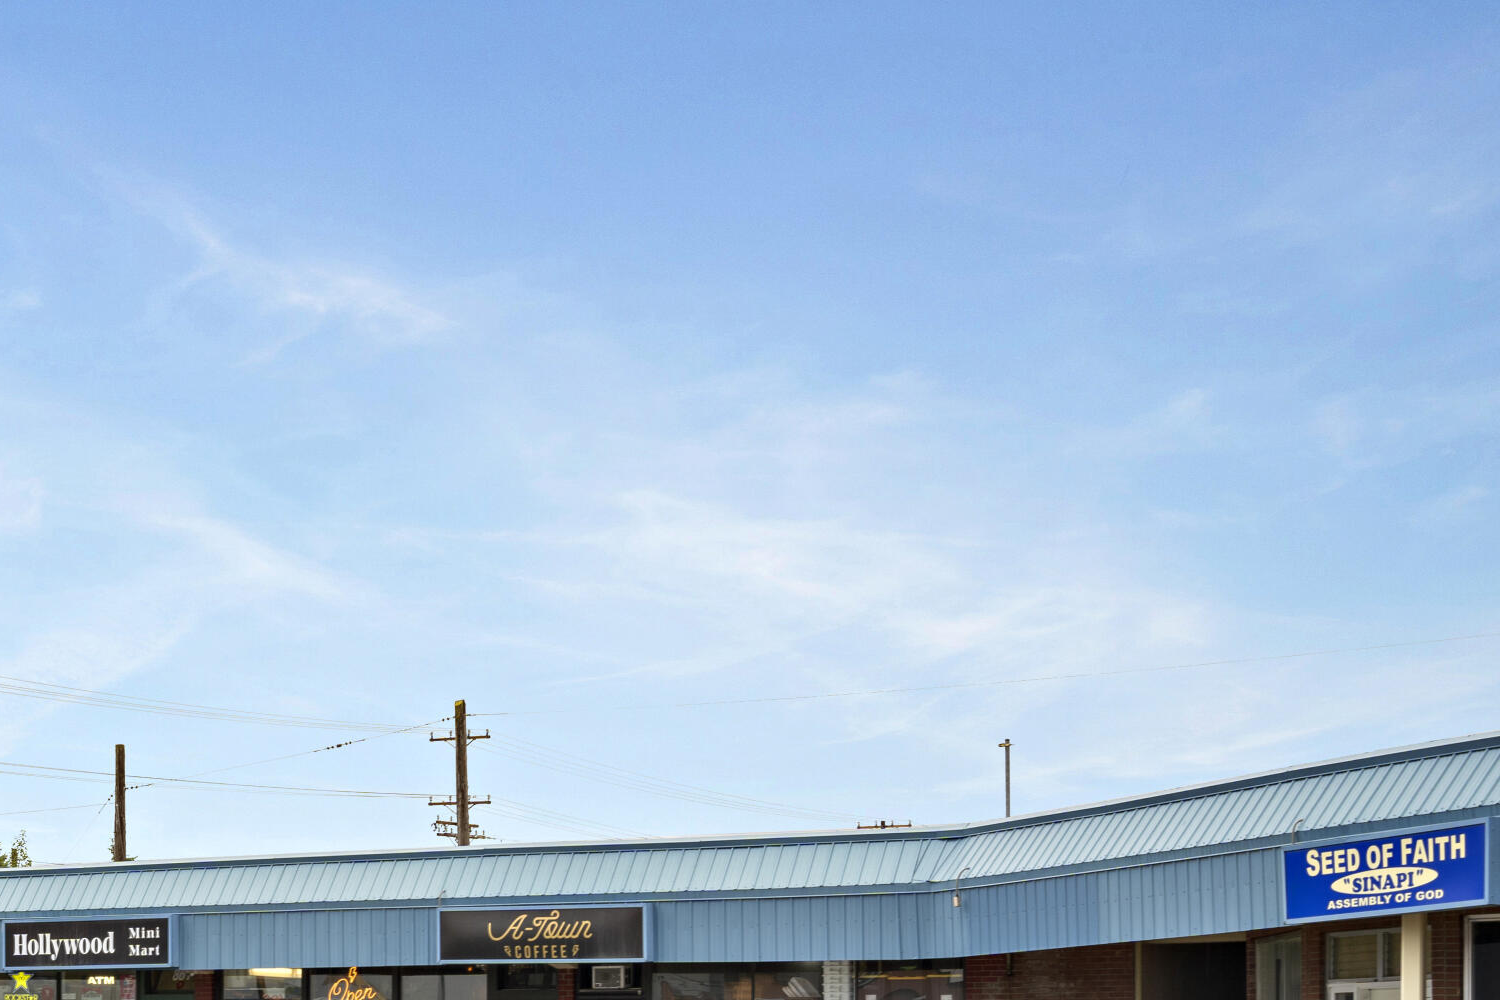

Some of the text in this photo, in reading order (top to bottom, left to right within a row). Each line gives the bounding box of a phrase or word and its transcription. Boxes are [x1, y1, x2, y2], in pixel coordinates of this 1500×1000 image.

[1306, 833, 1466, 877] SEED OF FAITH
[1343, 869, 1423, 893] "SINAPI"
[1327, 889, 1444, 910] ASSEMBLY OF GOD
[128, 927, 160, 939] Mini
[487, 910, 593, 941] A-Town
[13, 931, 116, 961] Hollywood
[128, 944, 160, 956] Mart
[515, 945, 568, 958] COFFEE
[87, 976, 115, 985] ATM
